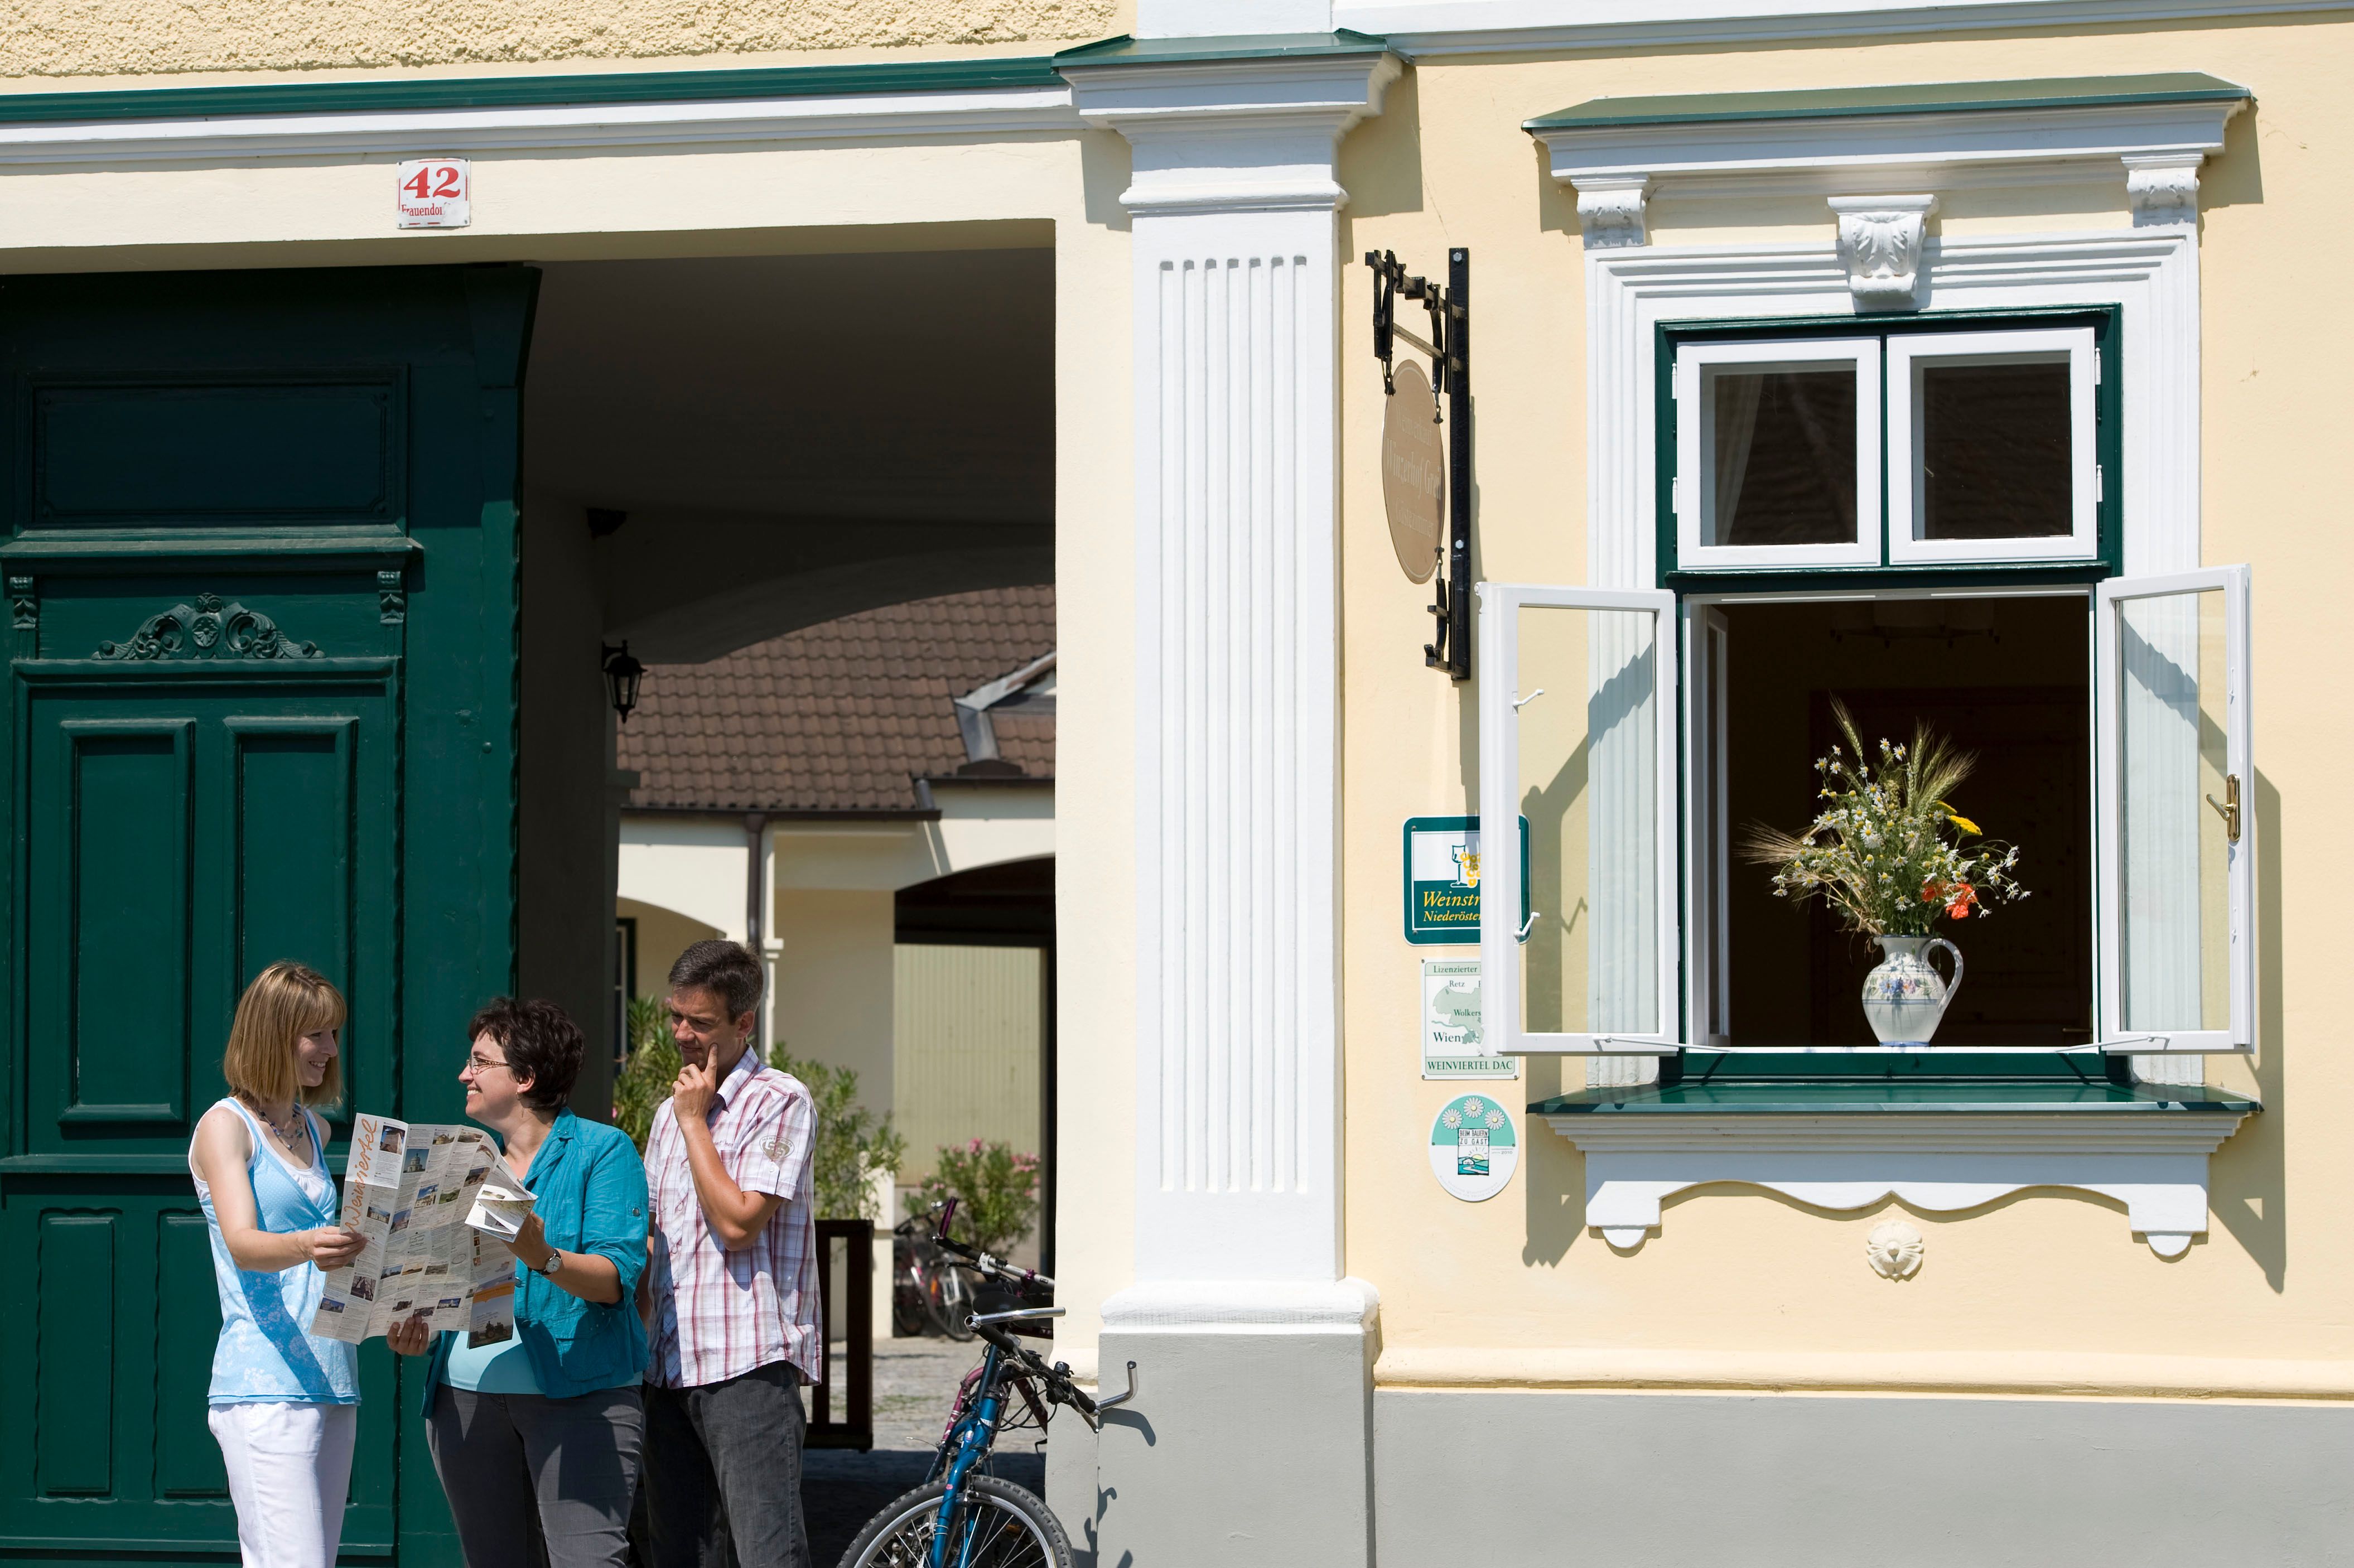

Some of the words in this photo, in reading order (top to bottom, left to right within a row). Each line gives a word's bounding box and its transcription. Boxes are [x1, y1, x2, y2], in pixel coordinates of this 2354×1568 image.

[403, 167, 461, 199] 42
[401, 202, 451, 217] Frauendor
[1386, 437, 1424, 500] Winzerhof
[1424, 459, 1442, 501] Greil
[1433, 965, 1478, 973] Lizenzierter
[1433, 1032, 1461, 1043] Wien
[1427, 1061, 1490, 1070] WEINVIERTEL
[1493, 1060, 1513, 1070] DAC
